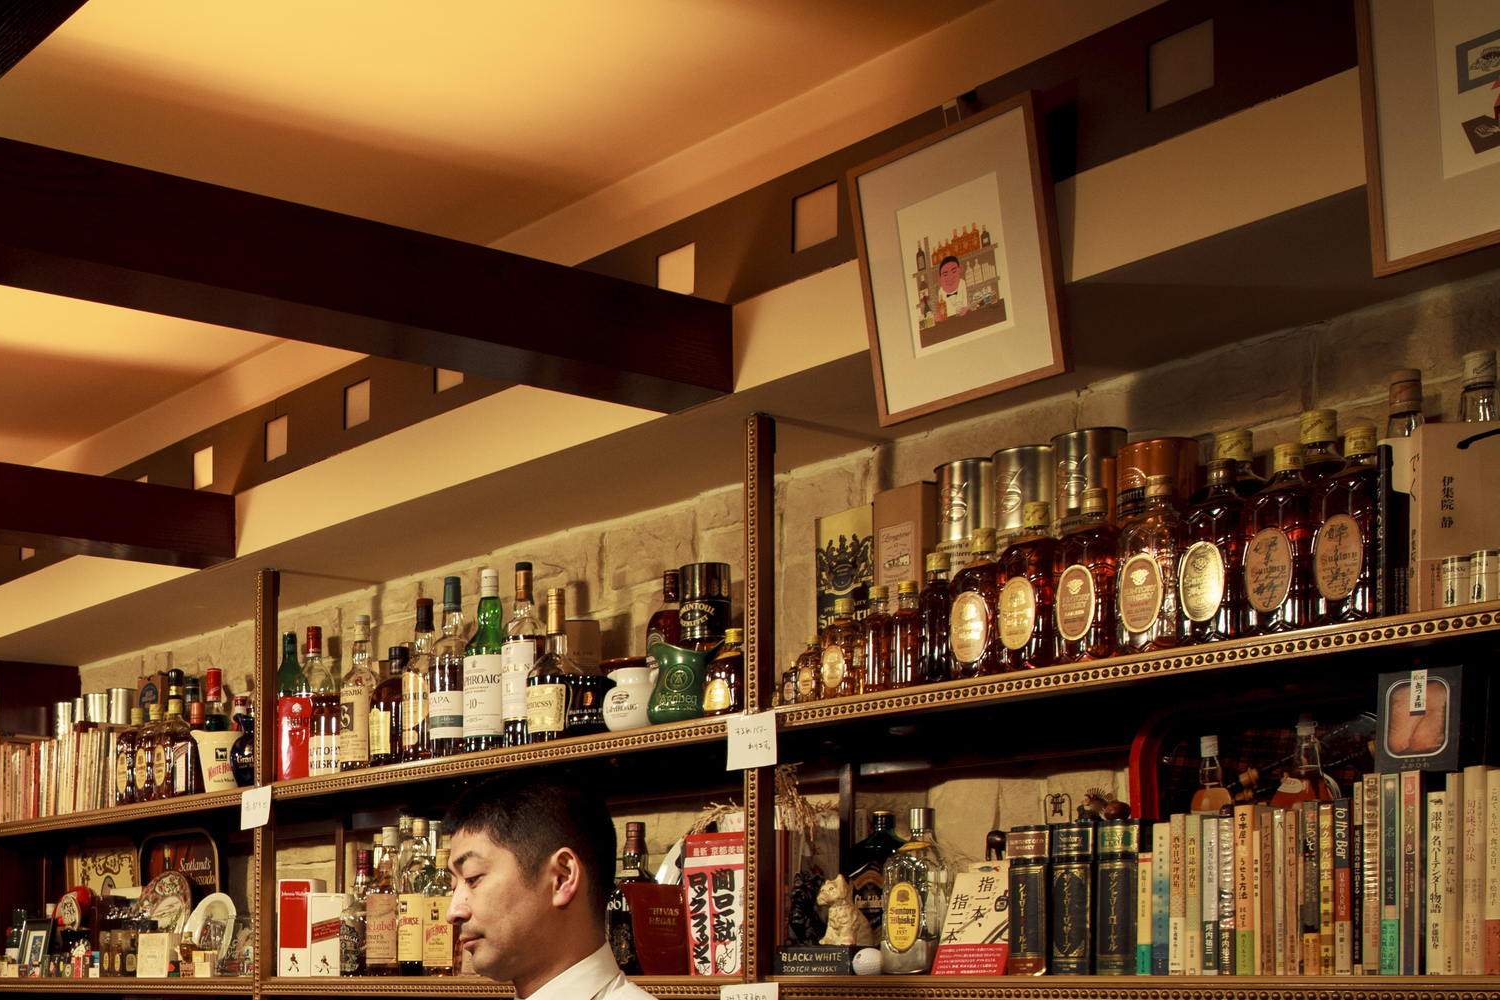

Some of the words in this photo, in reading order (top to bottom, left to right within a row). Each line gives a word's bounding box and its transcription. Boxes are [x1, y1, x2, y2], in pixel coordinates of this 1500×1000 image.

[465, 674, 501, 685] PHROAIG
[430, 696, 450, 704] CAPA
[527, 699, 554, 709] ennessy
[1336, 807, 1348, 819] to
[1431, 812, 1442, 831] 銀座
[1336, 822, 1348, 839] the
[711, 845, 744, 856] 京都美味
[1321, 820, 1332, 880] カクテルの本
[1336, 841, 1349, 859] Bar
[179, 857, 212, 873] Scotland's
[1430, 835, 1443, 914] 名バーテンダー物語
[890, 907, 916, 917] Suntory
[372, 919, 396, 931] Label
[649, 917, 677, 925] REGAL
[889, 916, 915, 927] Whisky
[782, 965, 809, 973] SCOTCH
[812, 965, 838, 973] WHISKY
